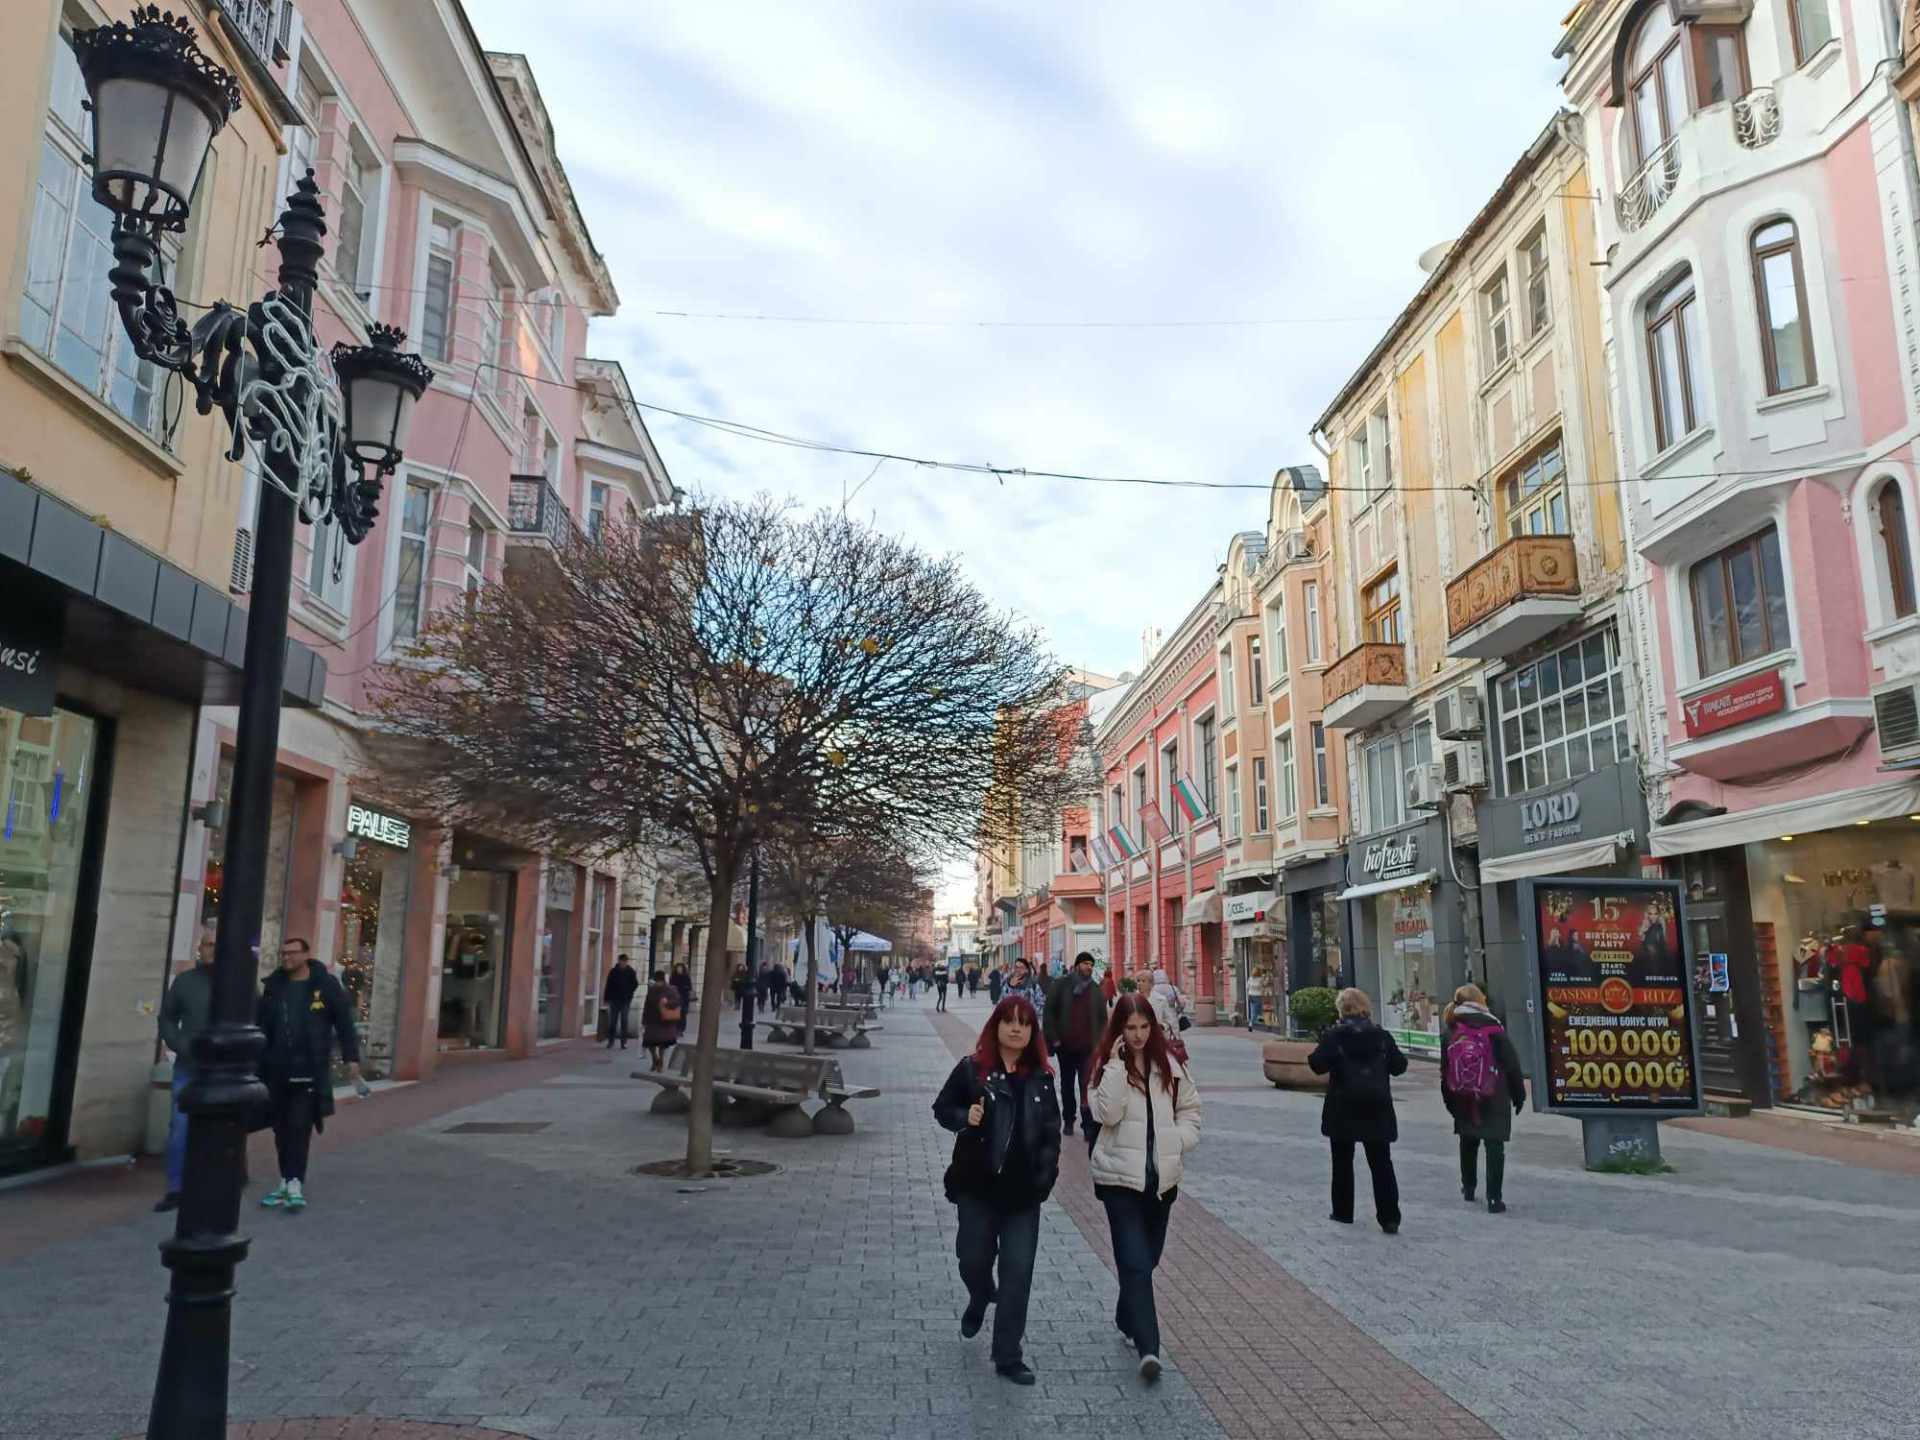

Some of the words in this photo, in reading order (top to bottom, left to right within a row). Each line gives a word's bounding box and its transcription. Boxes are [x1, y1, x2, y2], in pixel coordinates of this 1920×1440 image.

[0, 641, 40, 674] nsi
[1520, 792, 1579, 830] LORD
[347, 805, 410, 848] PAUSE
[1524, 831, 1545, 845] MEN'S
[1549, 824, 1581, 838] FASHION
[1363, 834, 1416, 880] biofresh
[1383, 868, 1414, 880] cosmetics
[1585, 931, 1631, 940] BIRTHDAY
[1594, 940, 1624, 948] PARTY
[1549, 988, 1598, 1000] CASINO
[1643, 989, 1676, 1003] RITZ
[1620, 1017, 1645, 1027] БОНУС
[1648, 1017, 1669, 1027] ИГРИ
[1565, 1029, 1617, 1056] 100
[1565, 1061, 1622, 1088] 200
